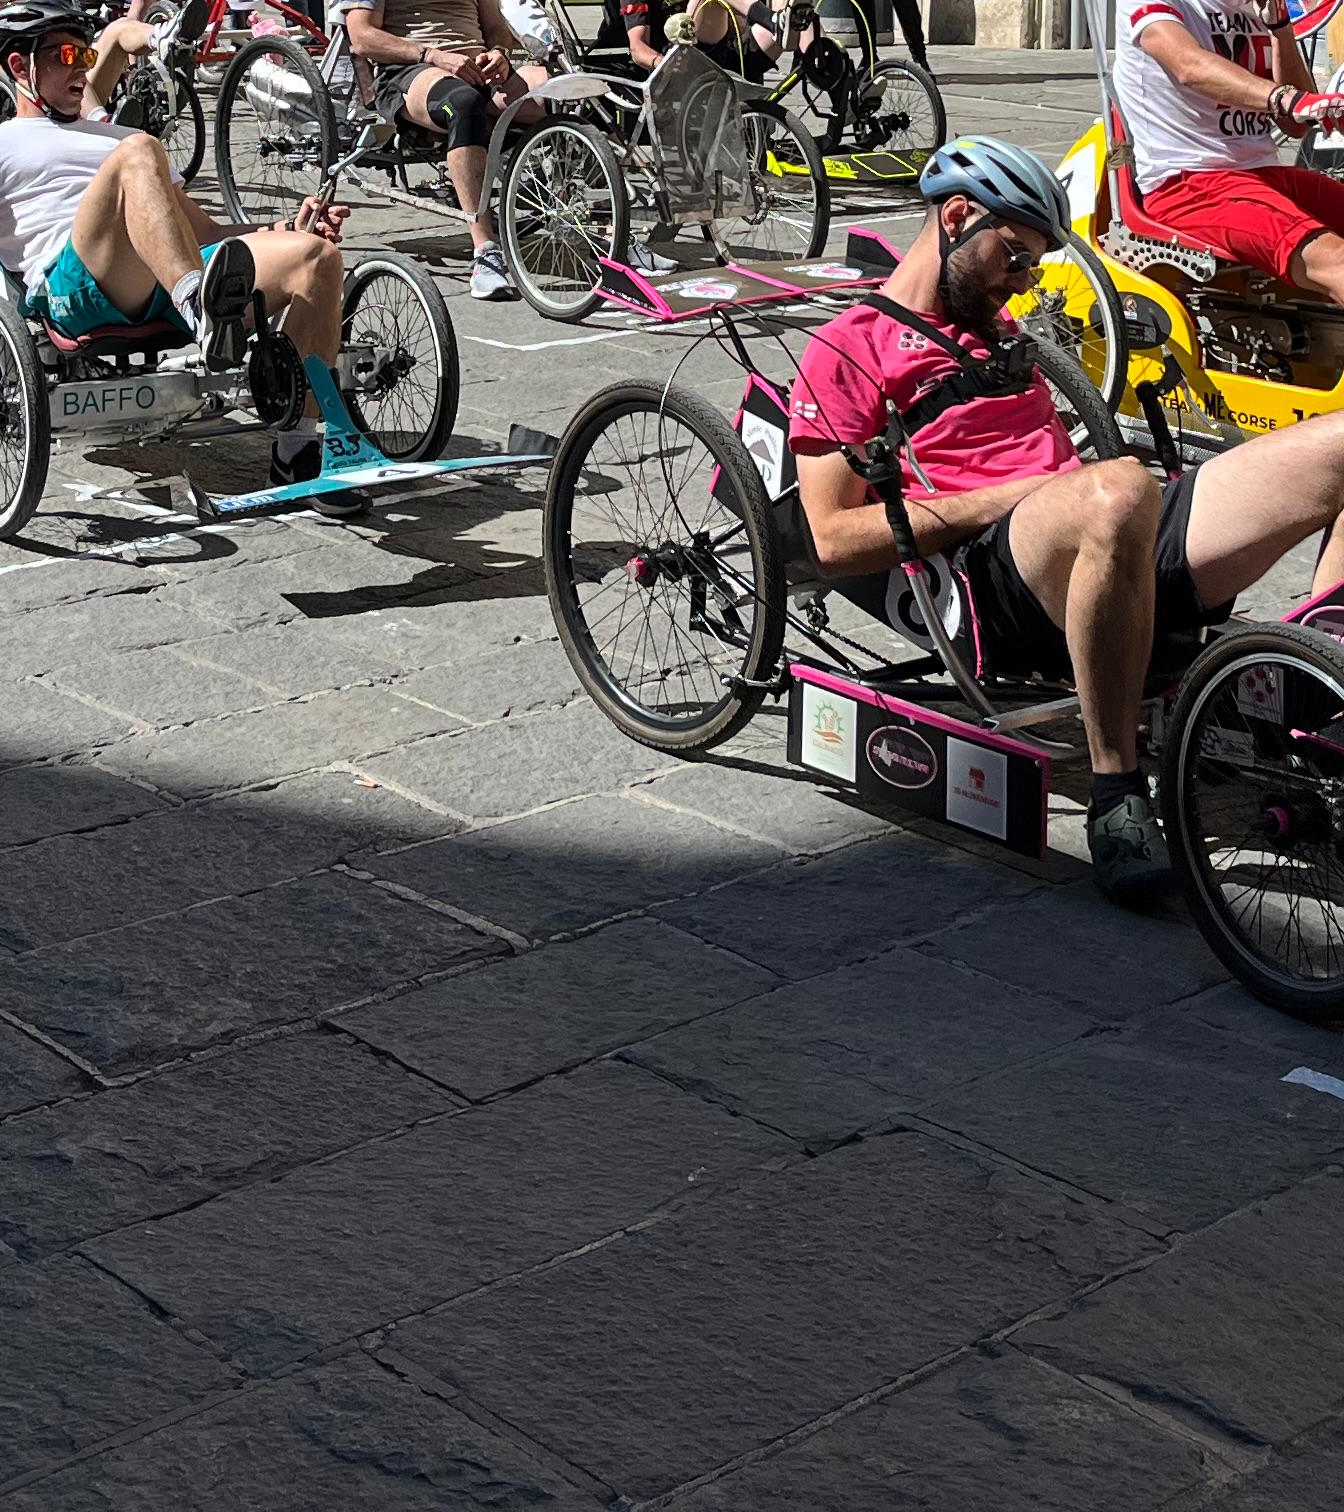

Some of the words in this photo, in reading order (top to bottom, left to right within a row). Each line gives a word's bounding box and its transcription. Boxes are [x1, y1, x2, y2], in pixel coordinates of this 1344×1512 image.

[1206, 12, 1253, 34] TEAM
[62, 385, 156, 416] BAFFO
[1204, 391, 1225, 421] ME
[1228, 410, 1278, 430] CORSE
